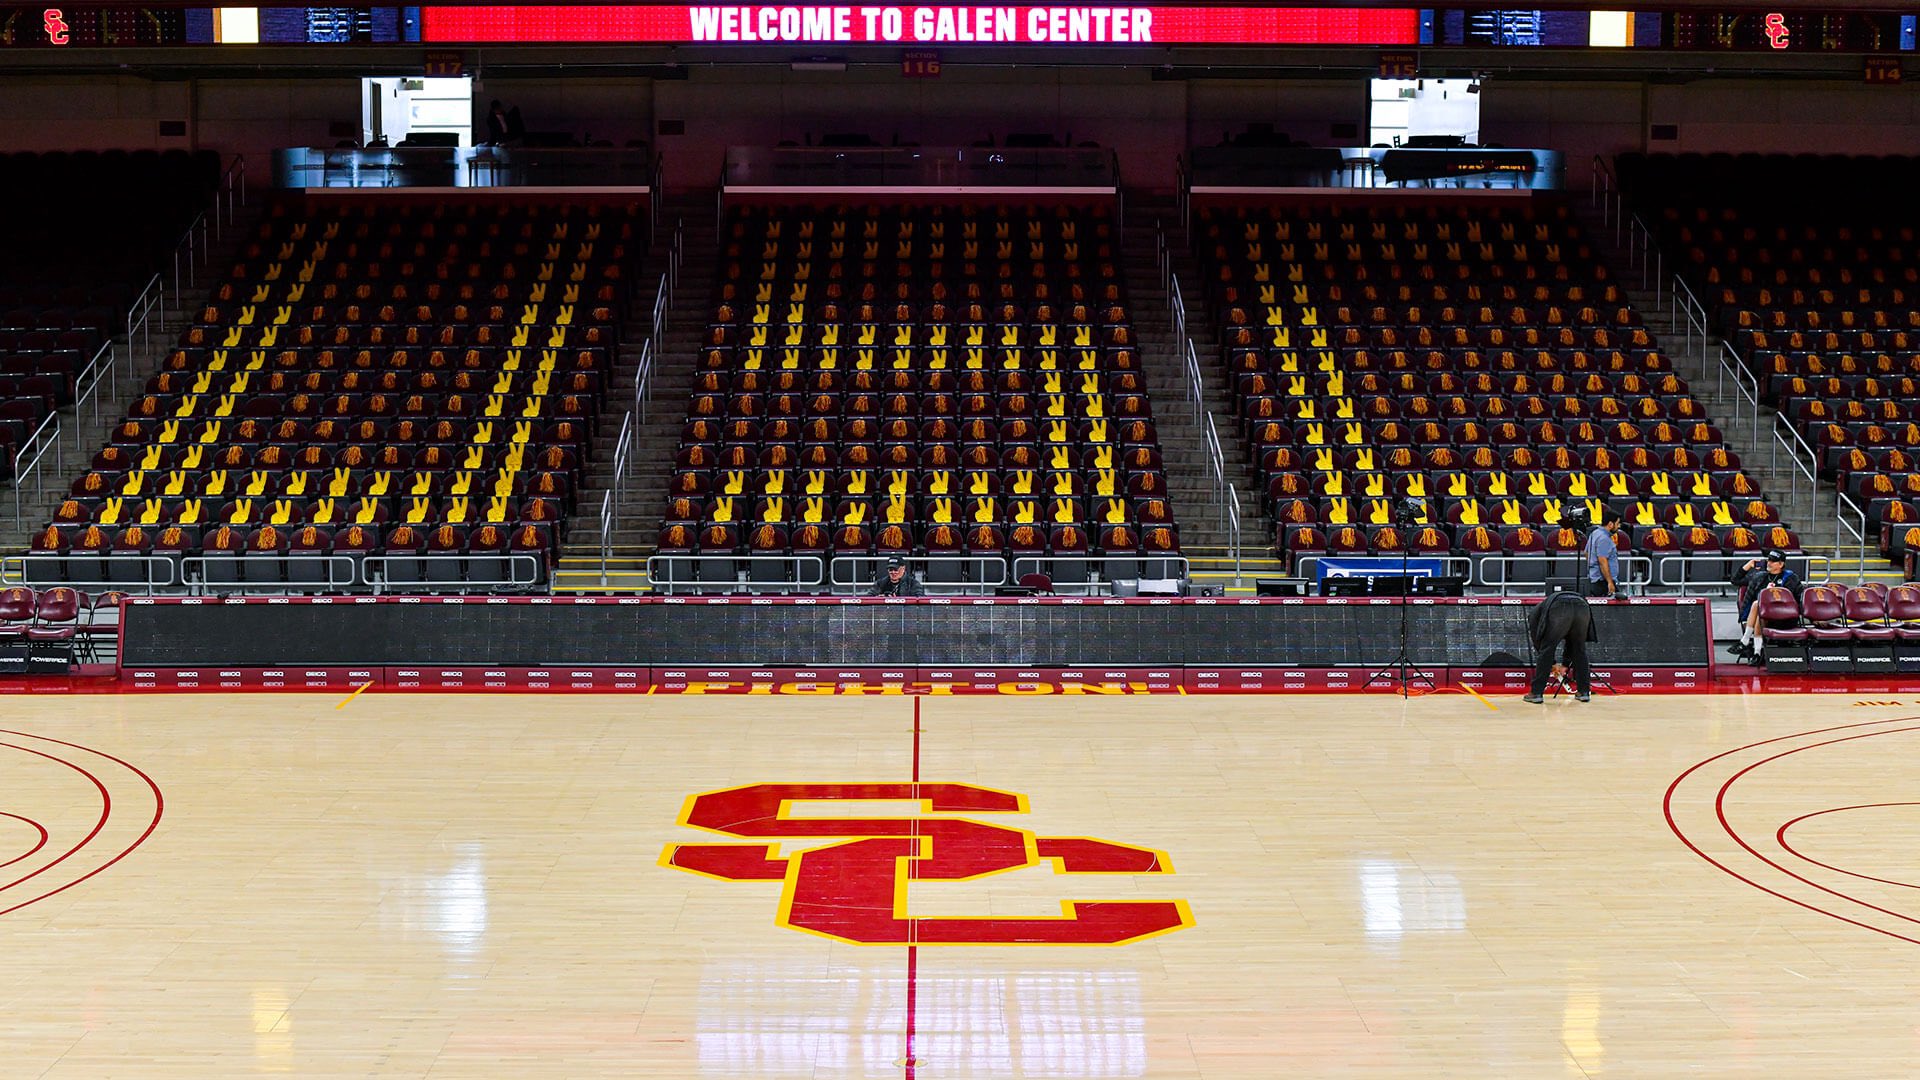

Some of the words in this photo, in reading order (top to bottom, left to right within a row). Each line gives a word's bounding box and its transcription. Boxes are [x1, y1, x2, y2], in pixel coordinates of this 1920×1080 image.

[43, 8, 70, 45] SC
[689, 7, 851, 41] WELCOME
[861, 7, 902, 41] TO
[913, 7, 1016, 41] GALEN
[1027, 8, 1153, 42] CENTER
[1765, 13, 1790, 49] SC
[424, 62, 463, 75] 117
[902, 61, 941, 74] 116
[1379, 64, 1415, 77] 115
[1865, 67, 1900, 80] 114
[681, 682, 969, 695] FIGHT
[657, 781, 1197, 947] SC
